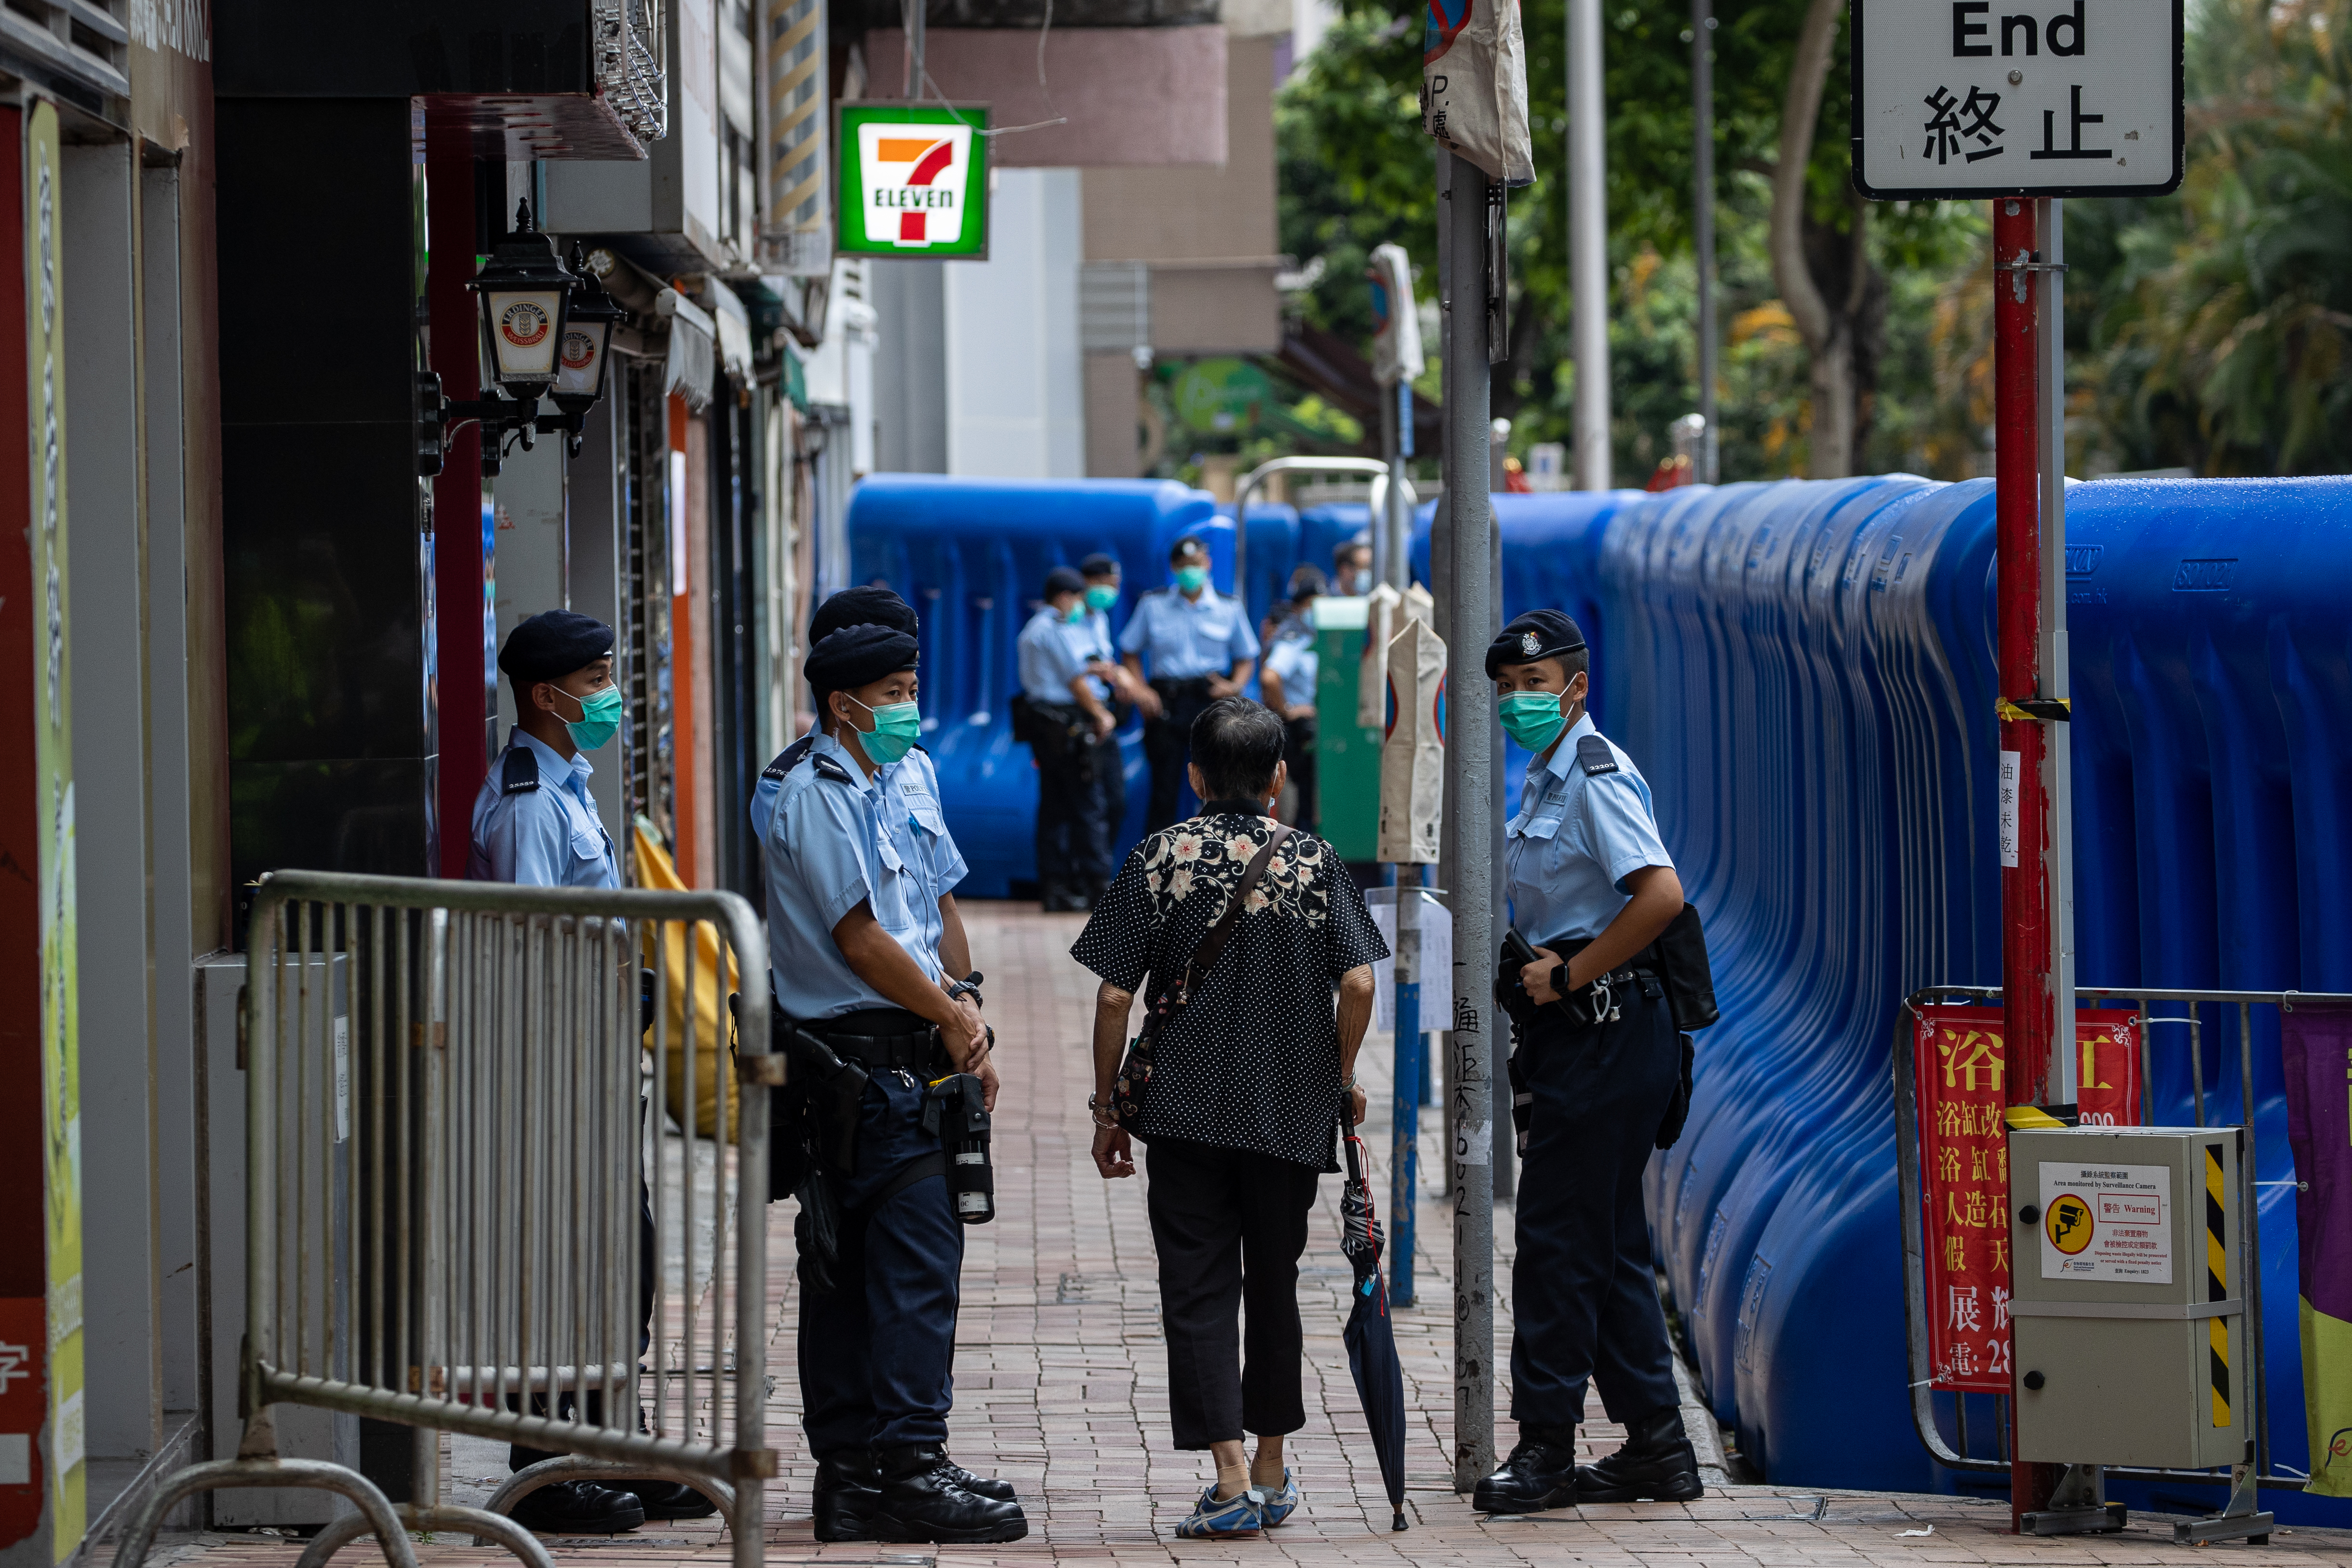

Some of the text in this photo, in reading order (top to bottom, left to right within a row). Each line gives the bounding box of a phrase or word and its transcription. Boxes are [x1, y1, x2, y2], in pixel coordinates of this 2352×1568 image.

[1953, 0, 2085, 57] End
[1923, 84, 2112, 165] 終止
[878, 138, 952, 240] 7
[503, 304, 545, 322] ERDINGER
[564, 333, 592, 348] DINGER
[2104, 1203, 2155, 1215] 警告 Warning
[2112, 1229, 2148, 1238] 非法棄置廢物
